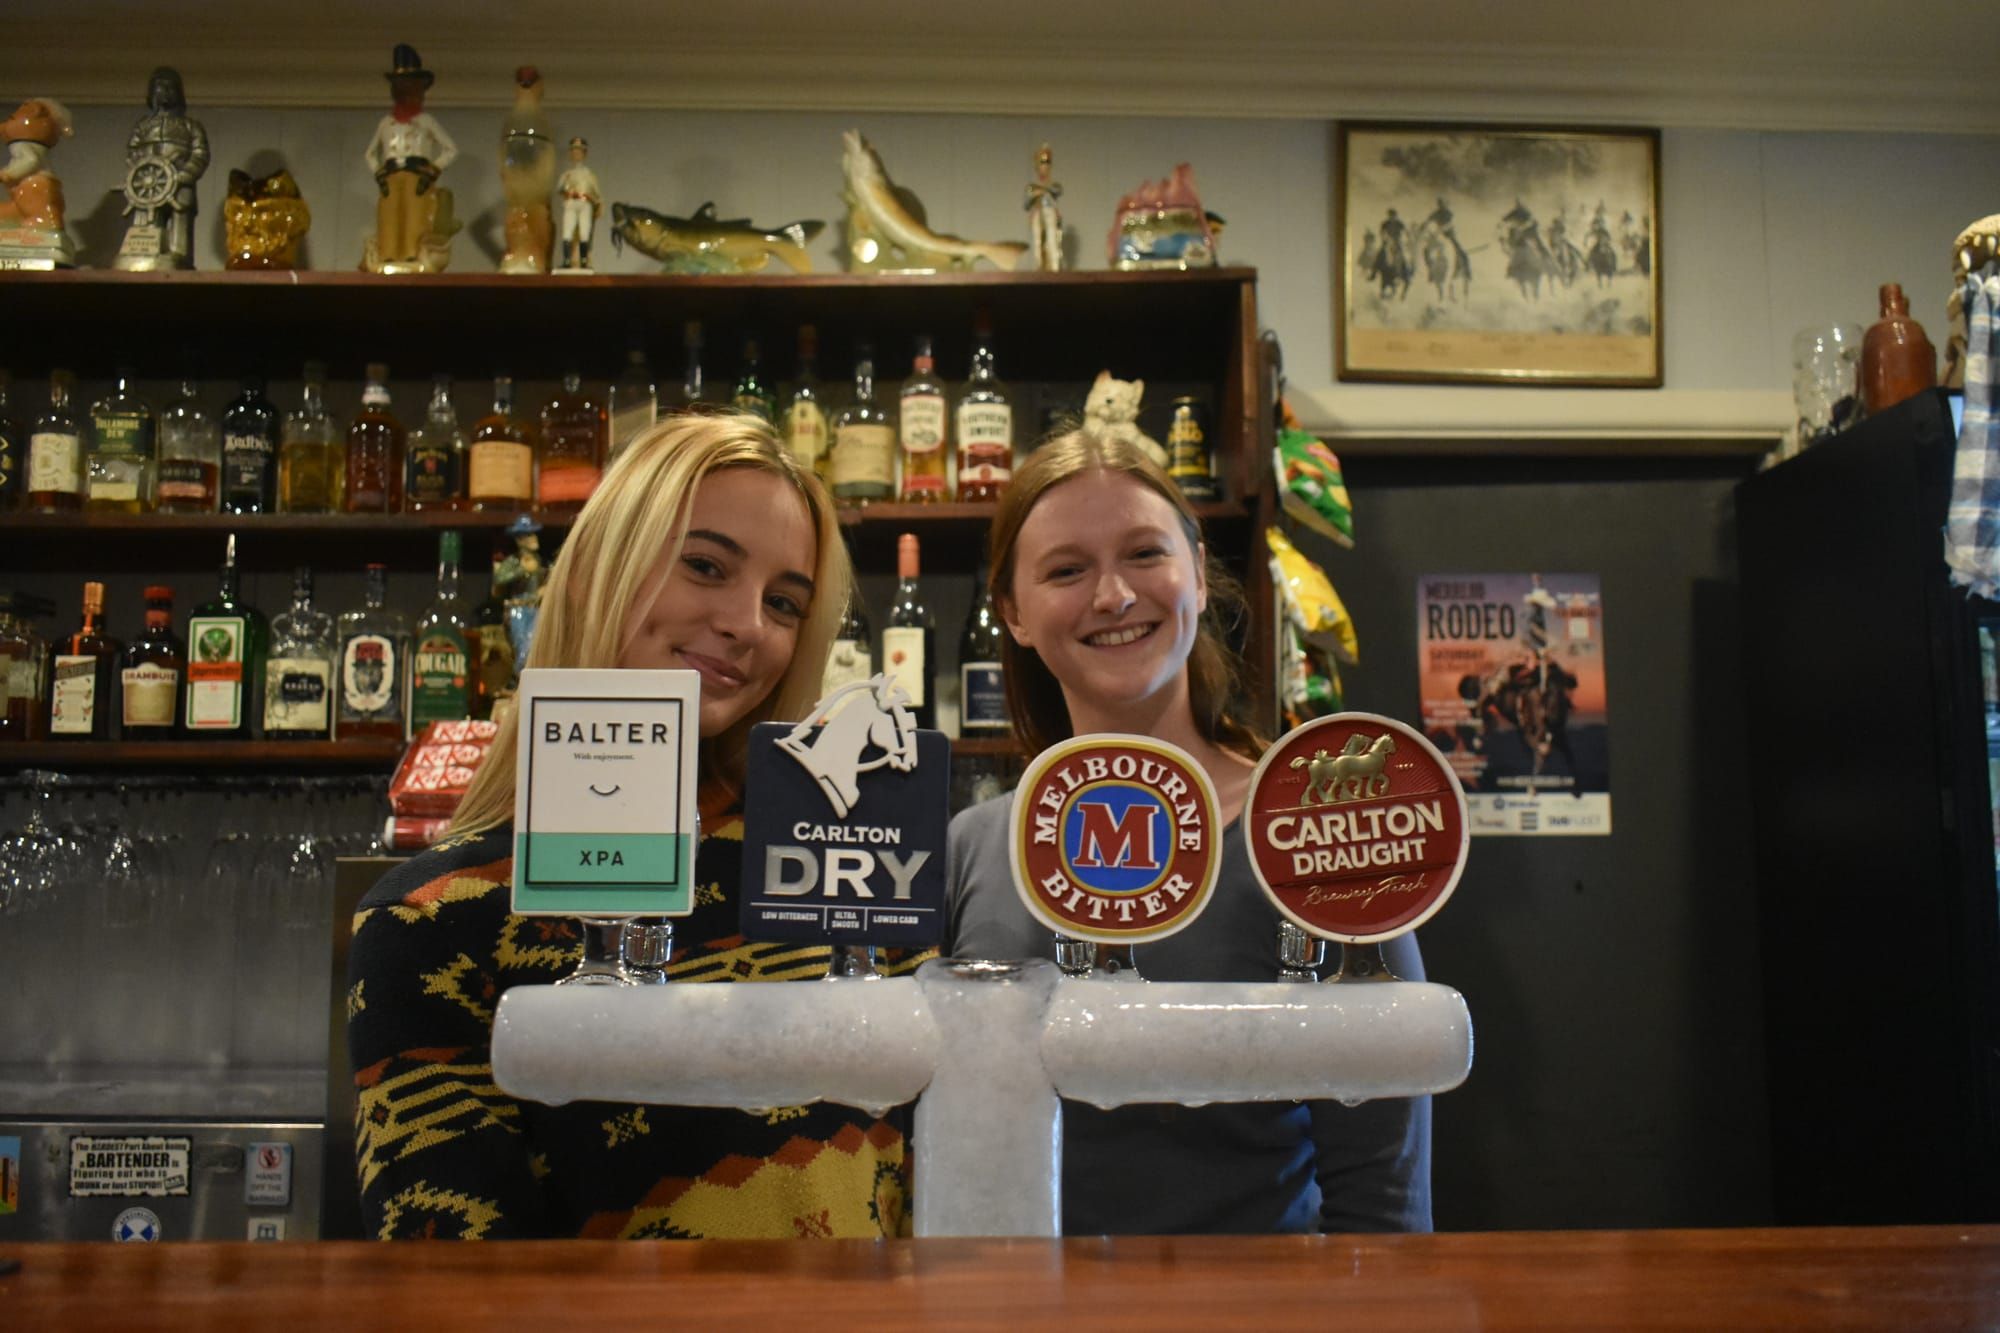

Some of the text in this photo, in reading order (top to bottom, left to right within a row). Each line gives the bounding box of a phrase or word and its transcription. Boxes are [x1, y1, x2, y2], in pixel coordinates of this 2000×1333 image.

[1427, 603, 1515, 640] RODEO
[545, 722, 668, 744] BALTER
[573, 752, 592, 761] With
[1034, 755, 1201, 851] MELBOURNE
[793, 821, 901, 844] CARLTON
[1072, 802, 1160, 869] M
[1267, 801, 1445, 850] CARLTON
[579, 850, 624, 866] XPA
[1292, 838, 1426, 876] DRAUGHT
[763, 844, 932, 900] DRY
[1041, 868, 1193, 922] BITTER
[762, 911, 778, 920] LOW
[832, 920, 860, 928] SMOOTH
[834, 911, 857, 920] ULTRA
[873, 915, 898, 923] LOWER
[86, 1152, 170, 1168] BARTENDER
[136, 1169, 156, 1178] who
